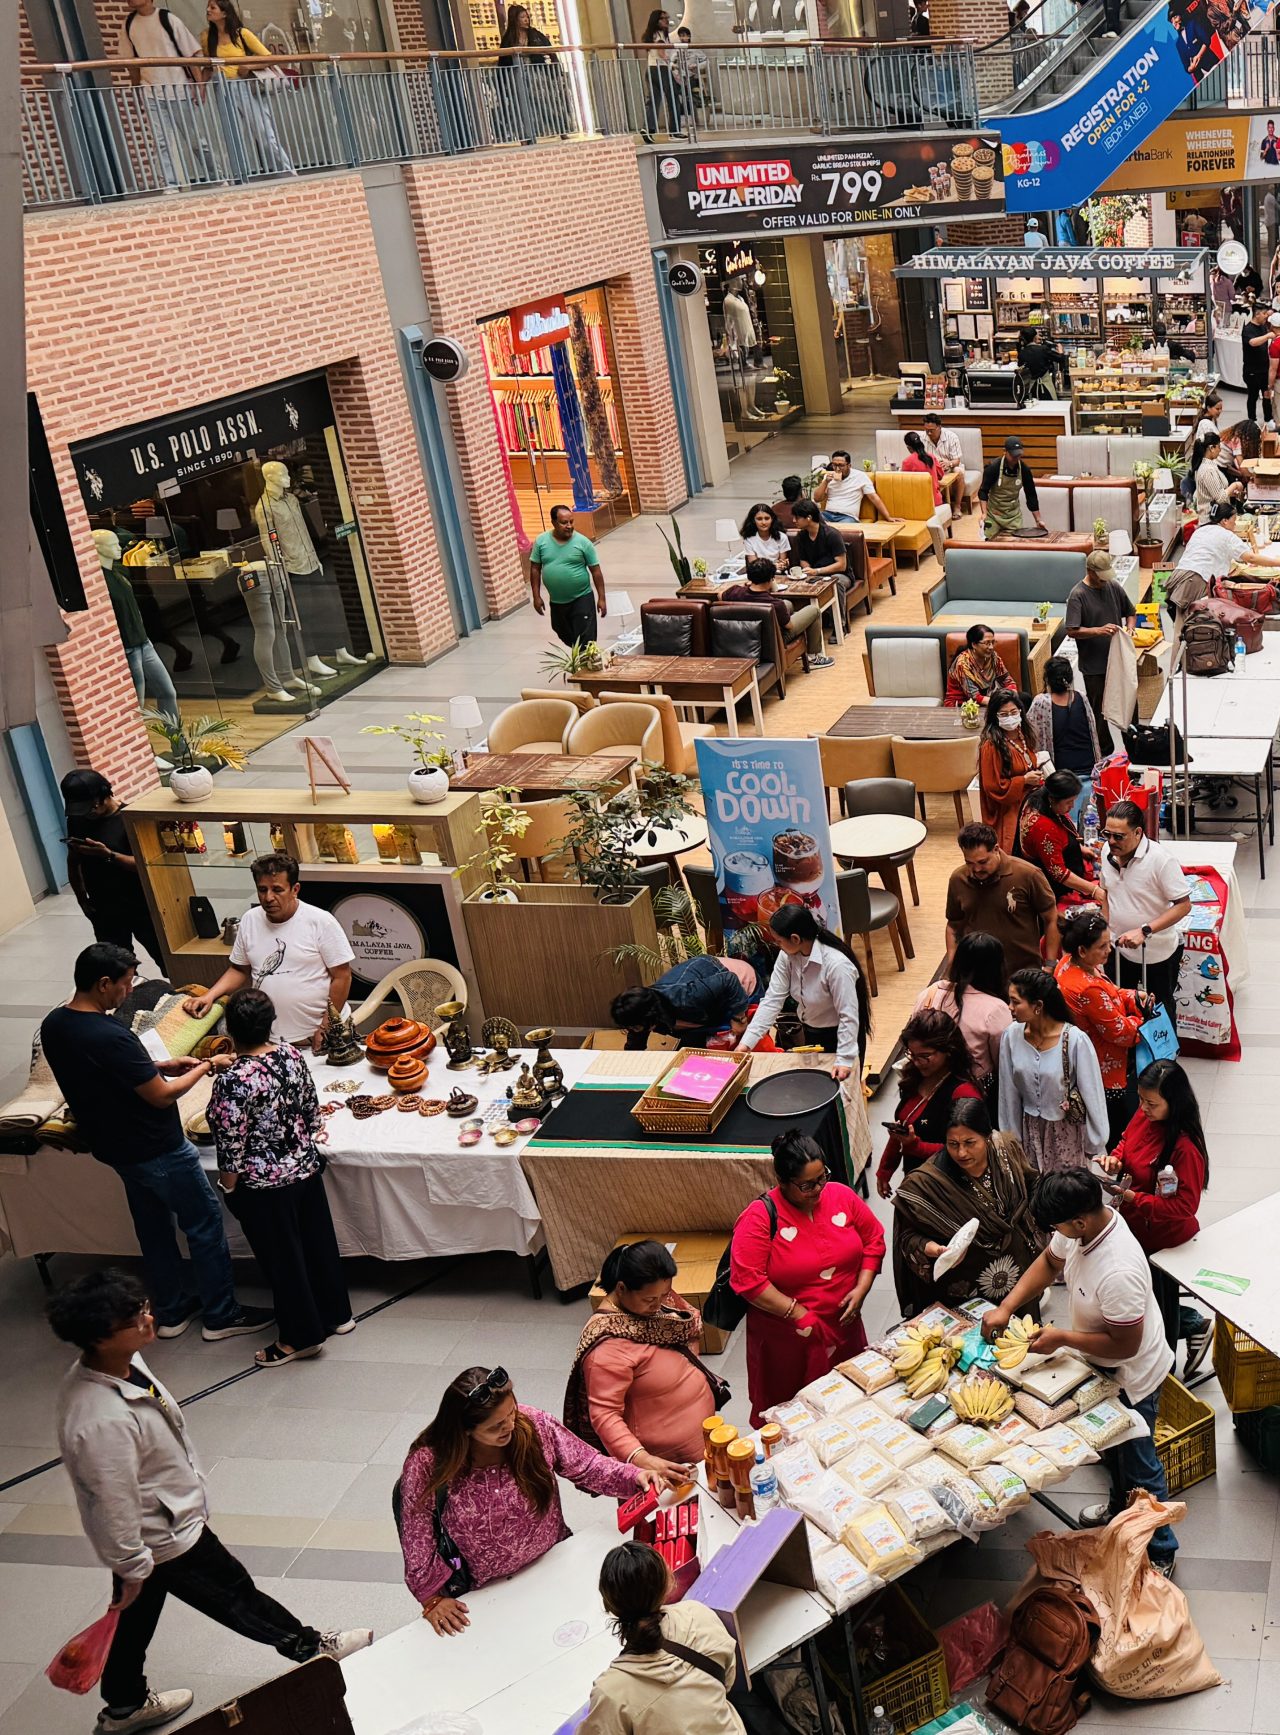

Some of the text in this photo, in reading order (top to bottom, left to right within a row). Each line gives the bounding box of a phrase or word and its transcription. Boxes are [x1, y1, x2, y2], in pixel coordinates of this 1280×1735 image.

[1060, 46, 1160, 152] REGISTRATION
[1087, 79, 1150, 146] OPEN FOR +2
[1103, 125, 1123, 150] IBDP
[1130, 102, 1149, 122] NEB
[1185, 130, 1234, 140] WHENEVER,
[1186, 139, 1234, 150] WHEREVER,
[1186, 149, 1235, 159] RELATIONSHIP
[812, 162, 833, 170] GARLIC
[817, 153, 844, 161] UNLIMITED
[1186, 157, 1235, 172] FOREVER
[699, 162, 790, 185] UNLIMITED
[1017, 178, 1041, 188] KG-12
[811, 170, 882, 205] Rs. 799
[688, 184, 804, 211] PIZZA FRIDAY
[762, 205, 921, 229] OFFER VALID FOR DINE-IN ONLY
[911, 254, 1175, 270] HIMALAYAN JAVA COFFEE
[131, 409, 263, 476] U.S. POLO ASSN.
[177, 451, 233, 477] SINCE 1890
[726, 771, 797, 796] COOL
[350, 941, 392, 949] MALAYAN
[364, 948, 394, 956] COFFEE
